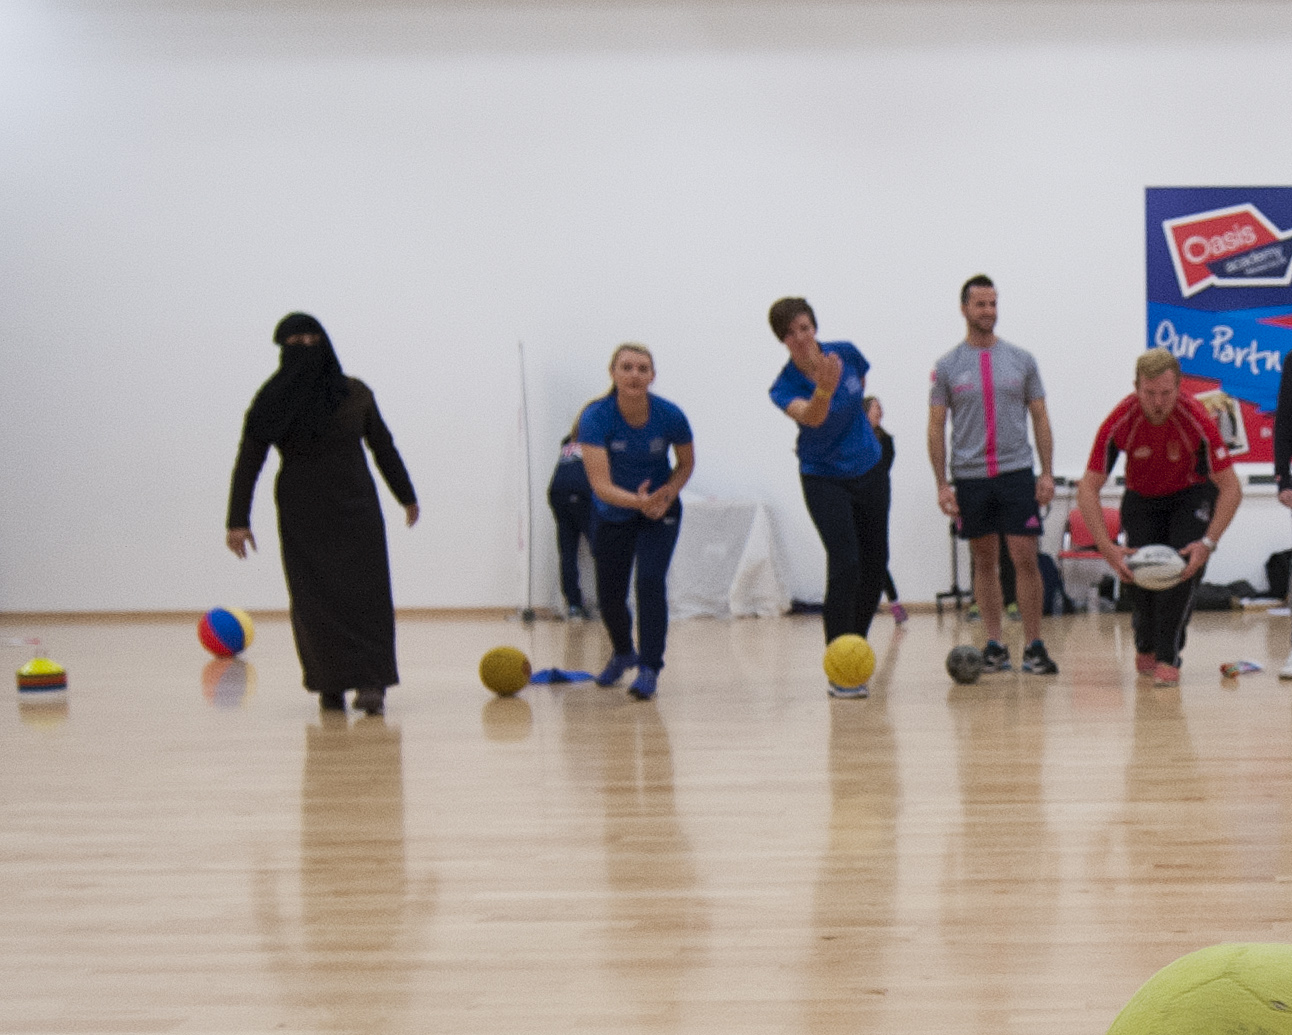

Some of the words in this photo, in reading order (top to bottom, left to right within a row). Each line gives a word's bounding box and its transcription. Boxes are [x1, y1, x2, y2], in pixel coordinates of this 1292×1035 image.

[1182, 223, 1257, 265] Oasis
[1155, 319, 1203, 359] Our
[1211, 325, 1282, 376] Partn
